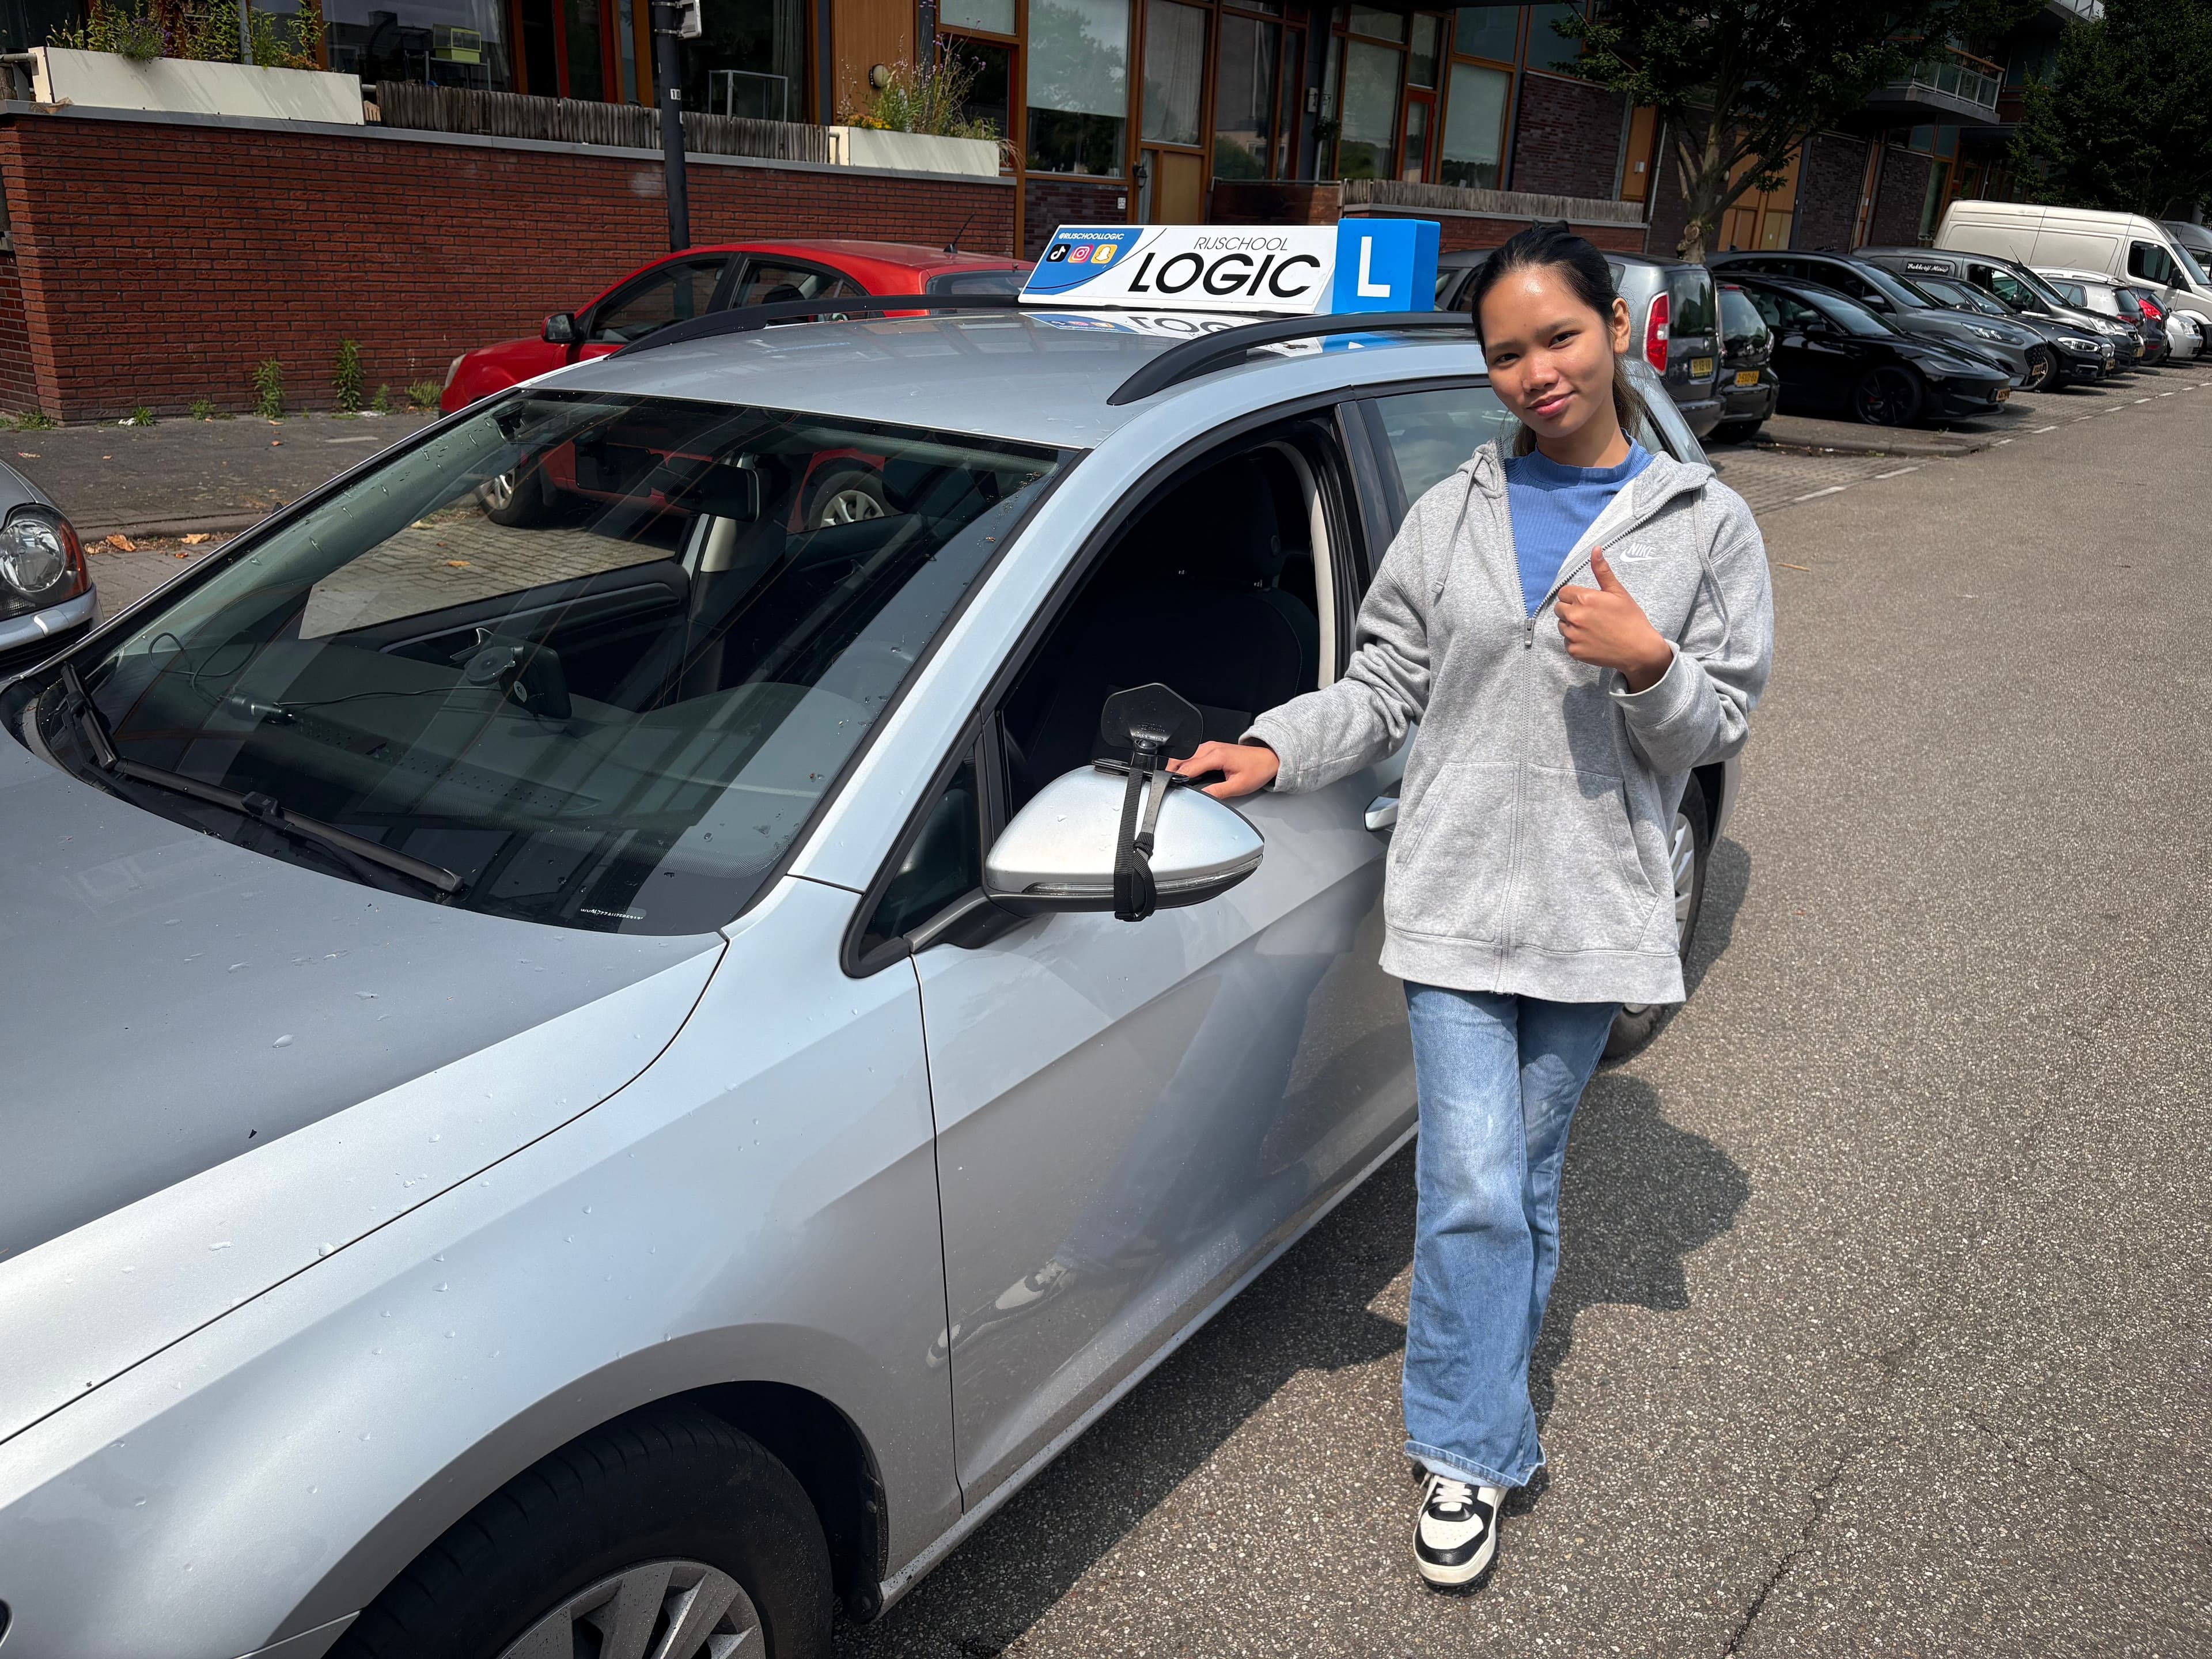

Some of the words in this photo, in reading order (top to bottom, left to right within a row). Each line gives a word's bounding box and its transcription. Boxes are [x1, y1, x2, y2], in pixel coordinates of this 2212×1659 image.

[1059, 232, 1125, 240] @RIJSCHOOLLOGIC
[1193, 237, 1289, 251] RIJSCHOOL
[1127, 252, 1321, 298] LOGIC
[1357, 236, 1391, 298] L
[1627, 542, 1657, 558] NIKE
